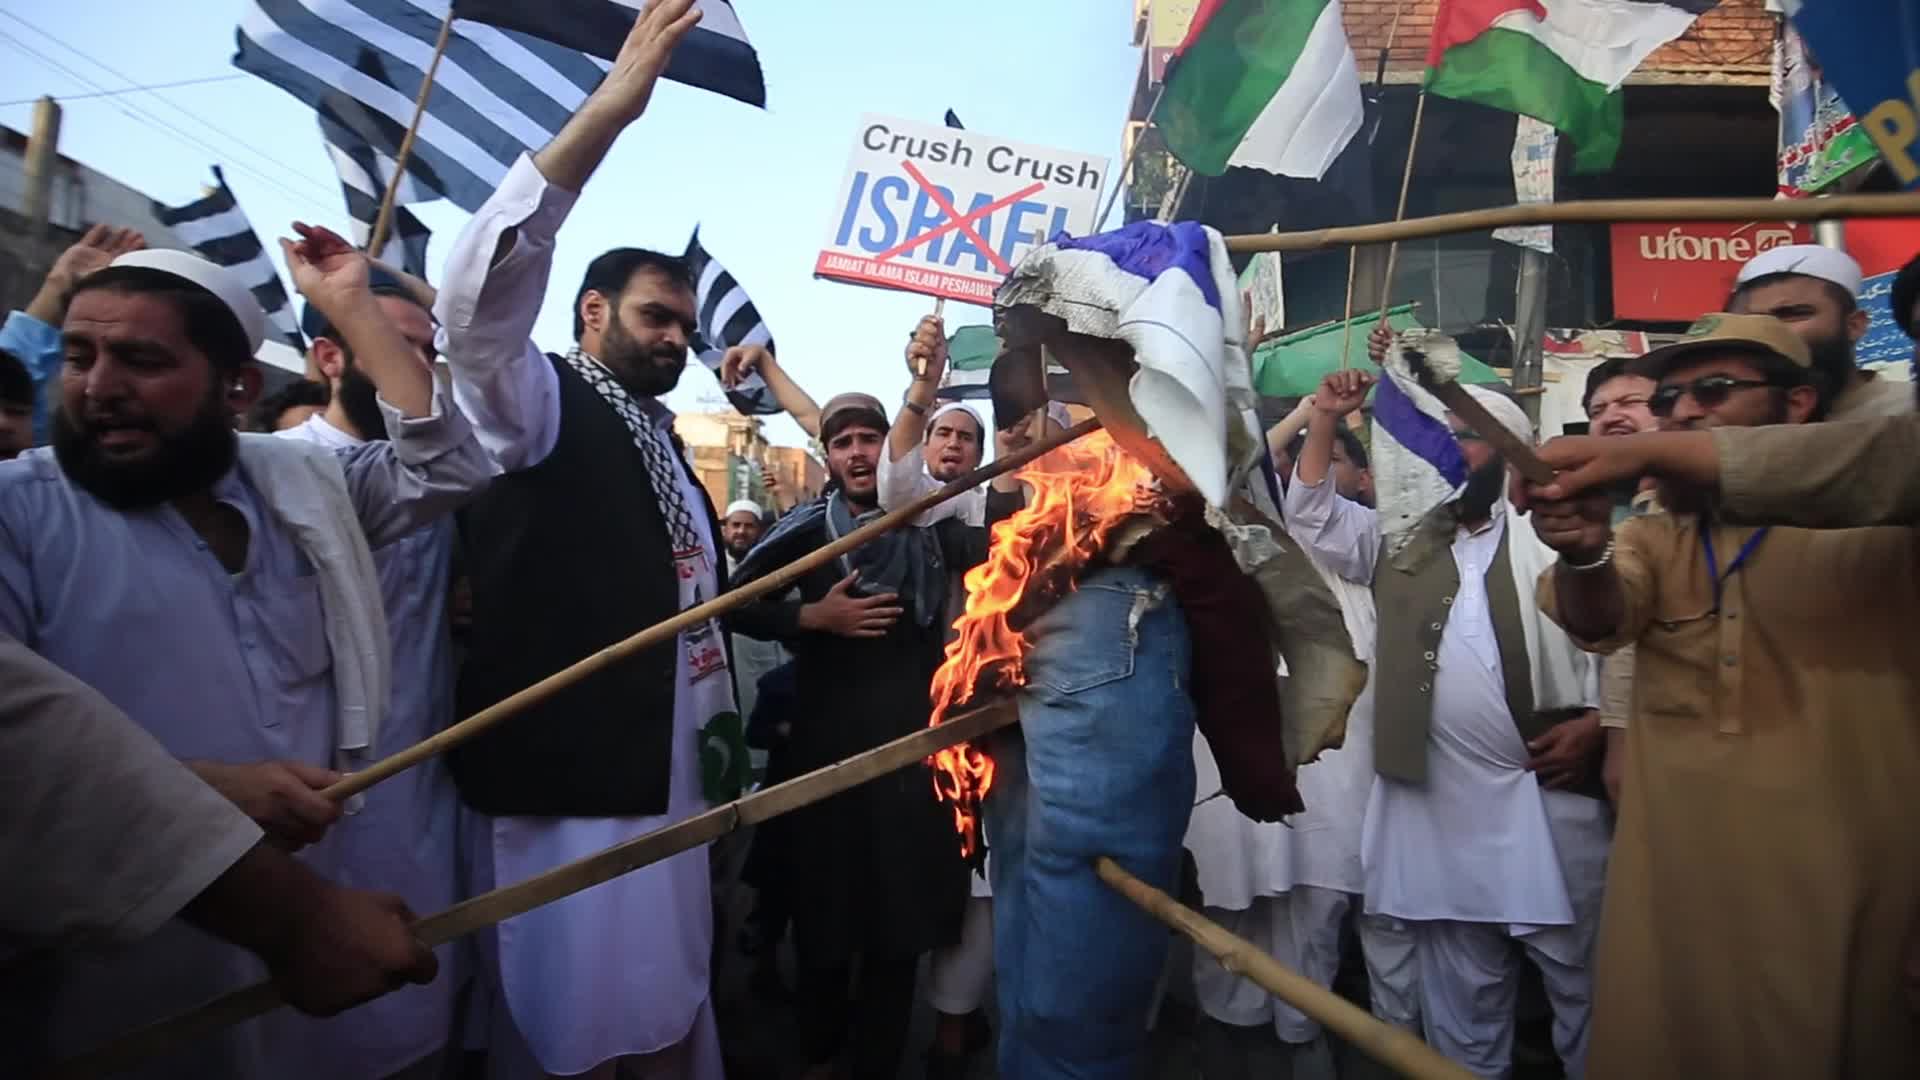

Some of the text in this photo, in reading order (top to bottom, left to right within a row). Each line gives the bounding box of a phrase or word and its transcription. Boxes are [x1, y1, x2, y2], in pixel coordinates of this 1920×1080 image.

[1863, 69, 1920, 183] P
[862, 124, 1100, 190] Crush Crush
[1640, 226, 1751, 261] ufone
[824, 254, 995, 297] JAMIAT ULAMA ISLAM PESHAWA
